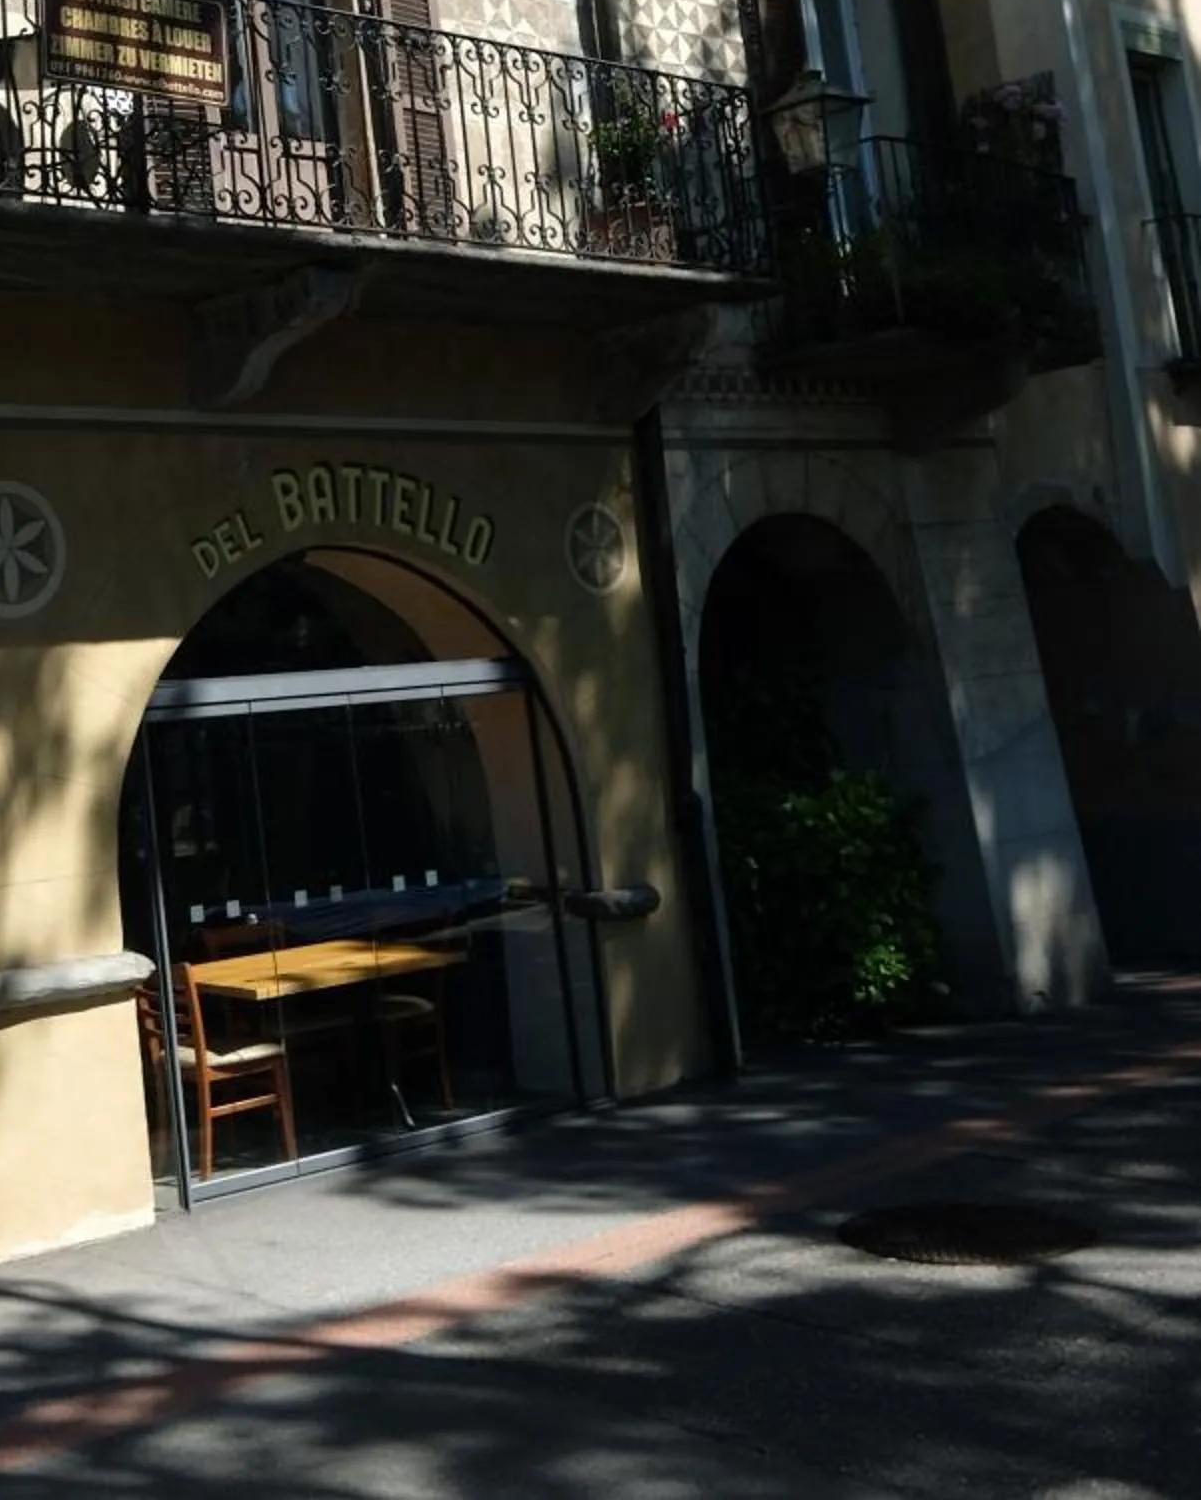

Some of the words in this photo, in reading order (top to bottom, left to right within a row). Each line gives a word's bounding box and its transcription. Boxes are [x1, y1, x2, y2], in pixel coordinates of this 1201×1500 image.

[60, 5, 148, 42] CHAMBRES
[166, 25, 212, 53] LOUER
[50, 33, 115, 64] ZIMMER
[117, 45, 138, 69] ZU
[140, 48, 223, 82] VERMIETEN
[190, 511, 264, 580] DEL
[271, 463, 494, 566] BATTELLO
